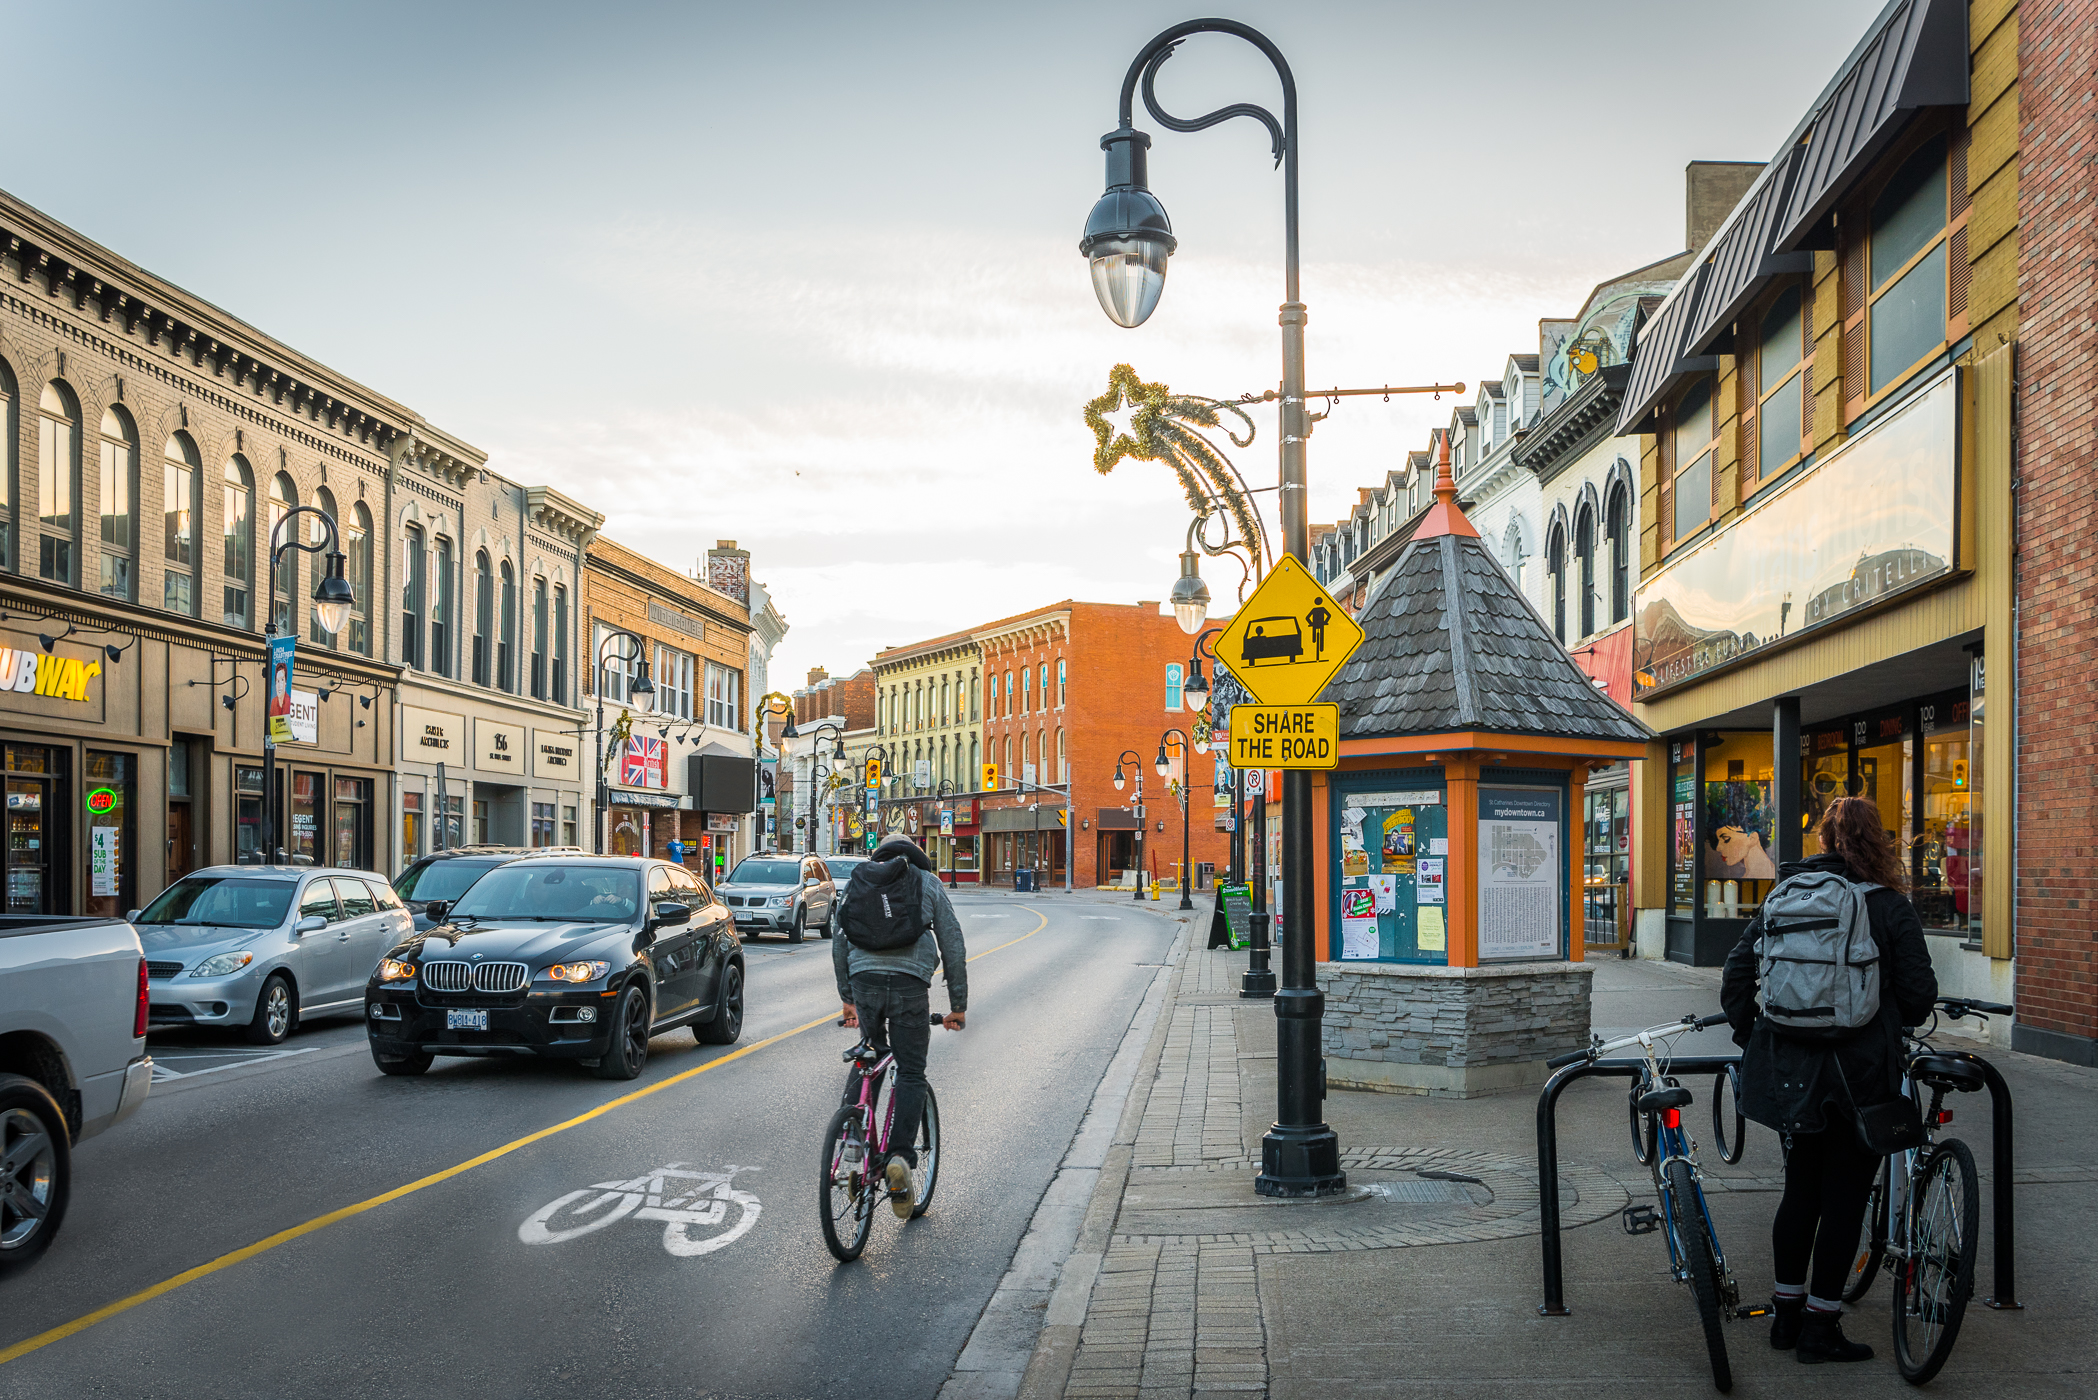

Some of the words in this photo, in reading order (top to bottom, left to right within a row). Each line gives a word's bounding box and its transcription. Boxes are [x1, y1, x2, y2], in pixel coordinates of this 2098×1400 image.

[1814, 590, 1831, 617] BY
[1842, 551, 1927, 604] CRITELLI
[0, 647, 101, 702] UBWAY
[1660, 646, 1710, 684] LIFESTYLE
[1254, 712, 1315, 734] SHARE
[1920, 706, 1935, 732] 100
[1952, 702, 1970, 723] OFFI
[1854, 721, 1867, 745] 100
[1880, 716, 1902, 738] DINING
[493, 733, 508, 751] 156
[1237, 738, 1273, 759] THE
[1281, 738, 1330, 759] ROAD
[1817, 730, 1844, 751] BEDROOM
[90, 794, 113, 807] OPEN
[1494, 808, 1546, 817] mydowntown.ca
[94, 833, 104, 848] $4
[94, 849, 106, 858] SUB
[94, 865, 106, 873] DAY
